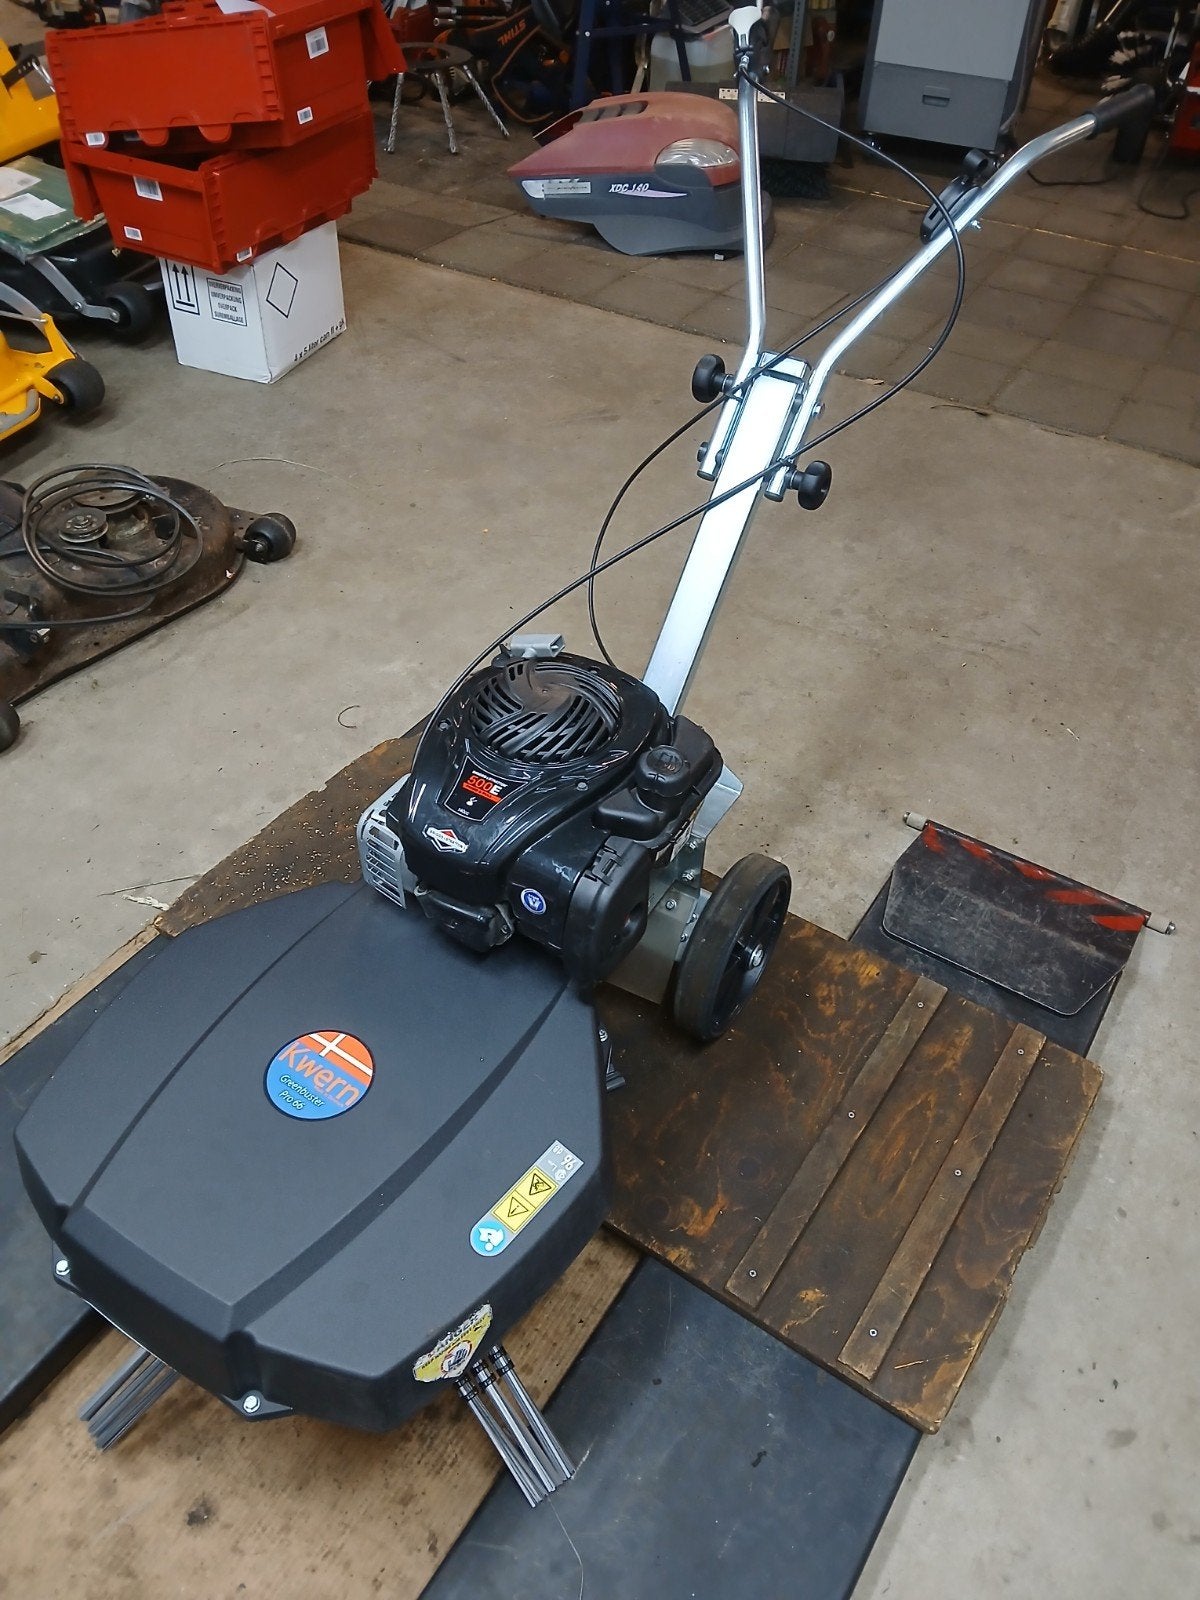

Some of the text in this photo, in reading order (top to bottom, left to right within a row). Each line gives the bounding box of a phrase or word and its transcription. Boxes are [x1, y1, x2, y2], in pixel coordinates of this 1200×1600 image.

[497, 19, 526, 46] STIHL
[609, 184, 629, 193] XDC
[218, 302, 237, 312] OVERPACK
[467, 775, 503, 796] 500E
[278, 1041, 360, 1107] Kwern
[279, 1090, 306, 1110] Pro 66
[280, 1074, 325, 1107] Greenbuster
[561, 1154, 576, 1170] 96
